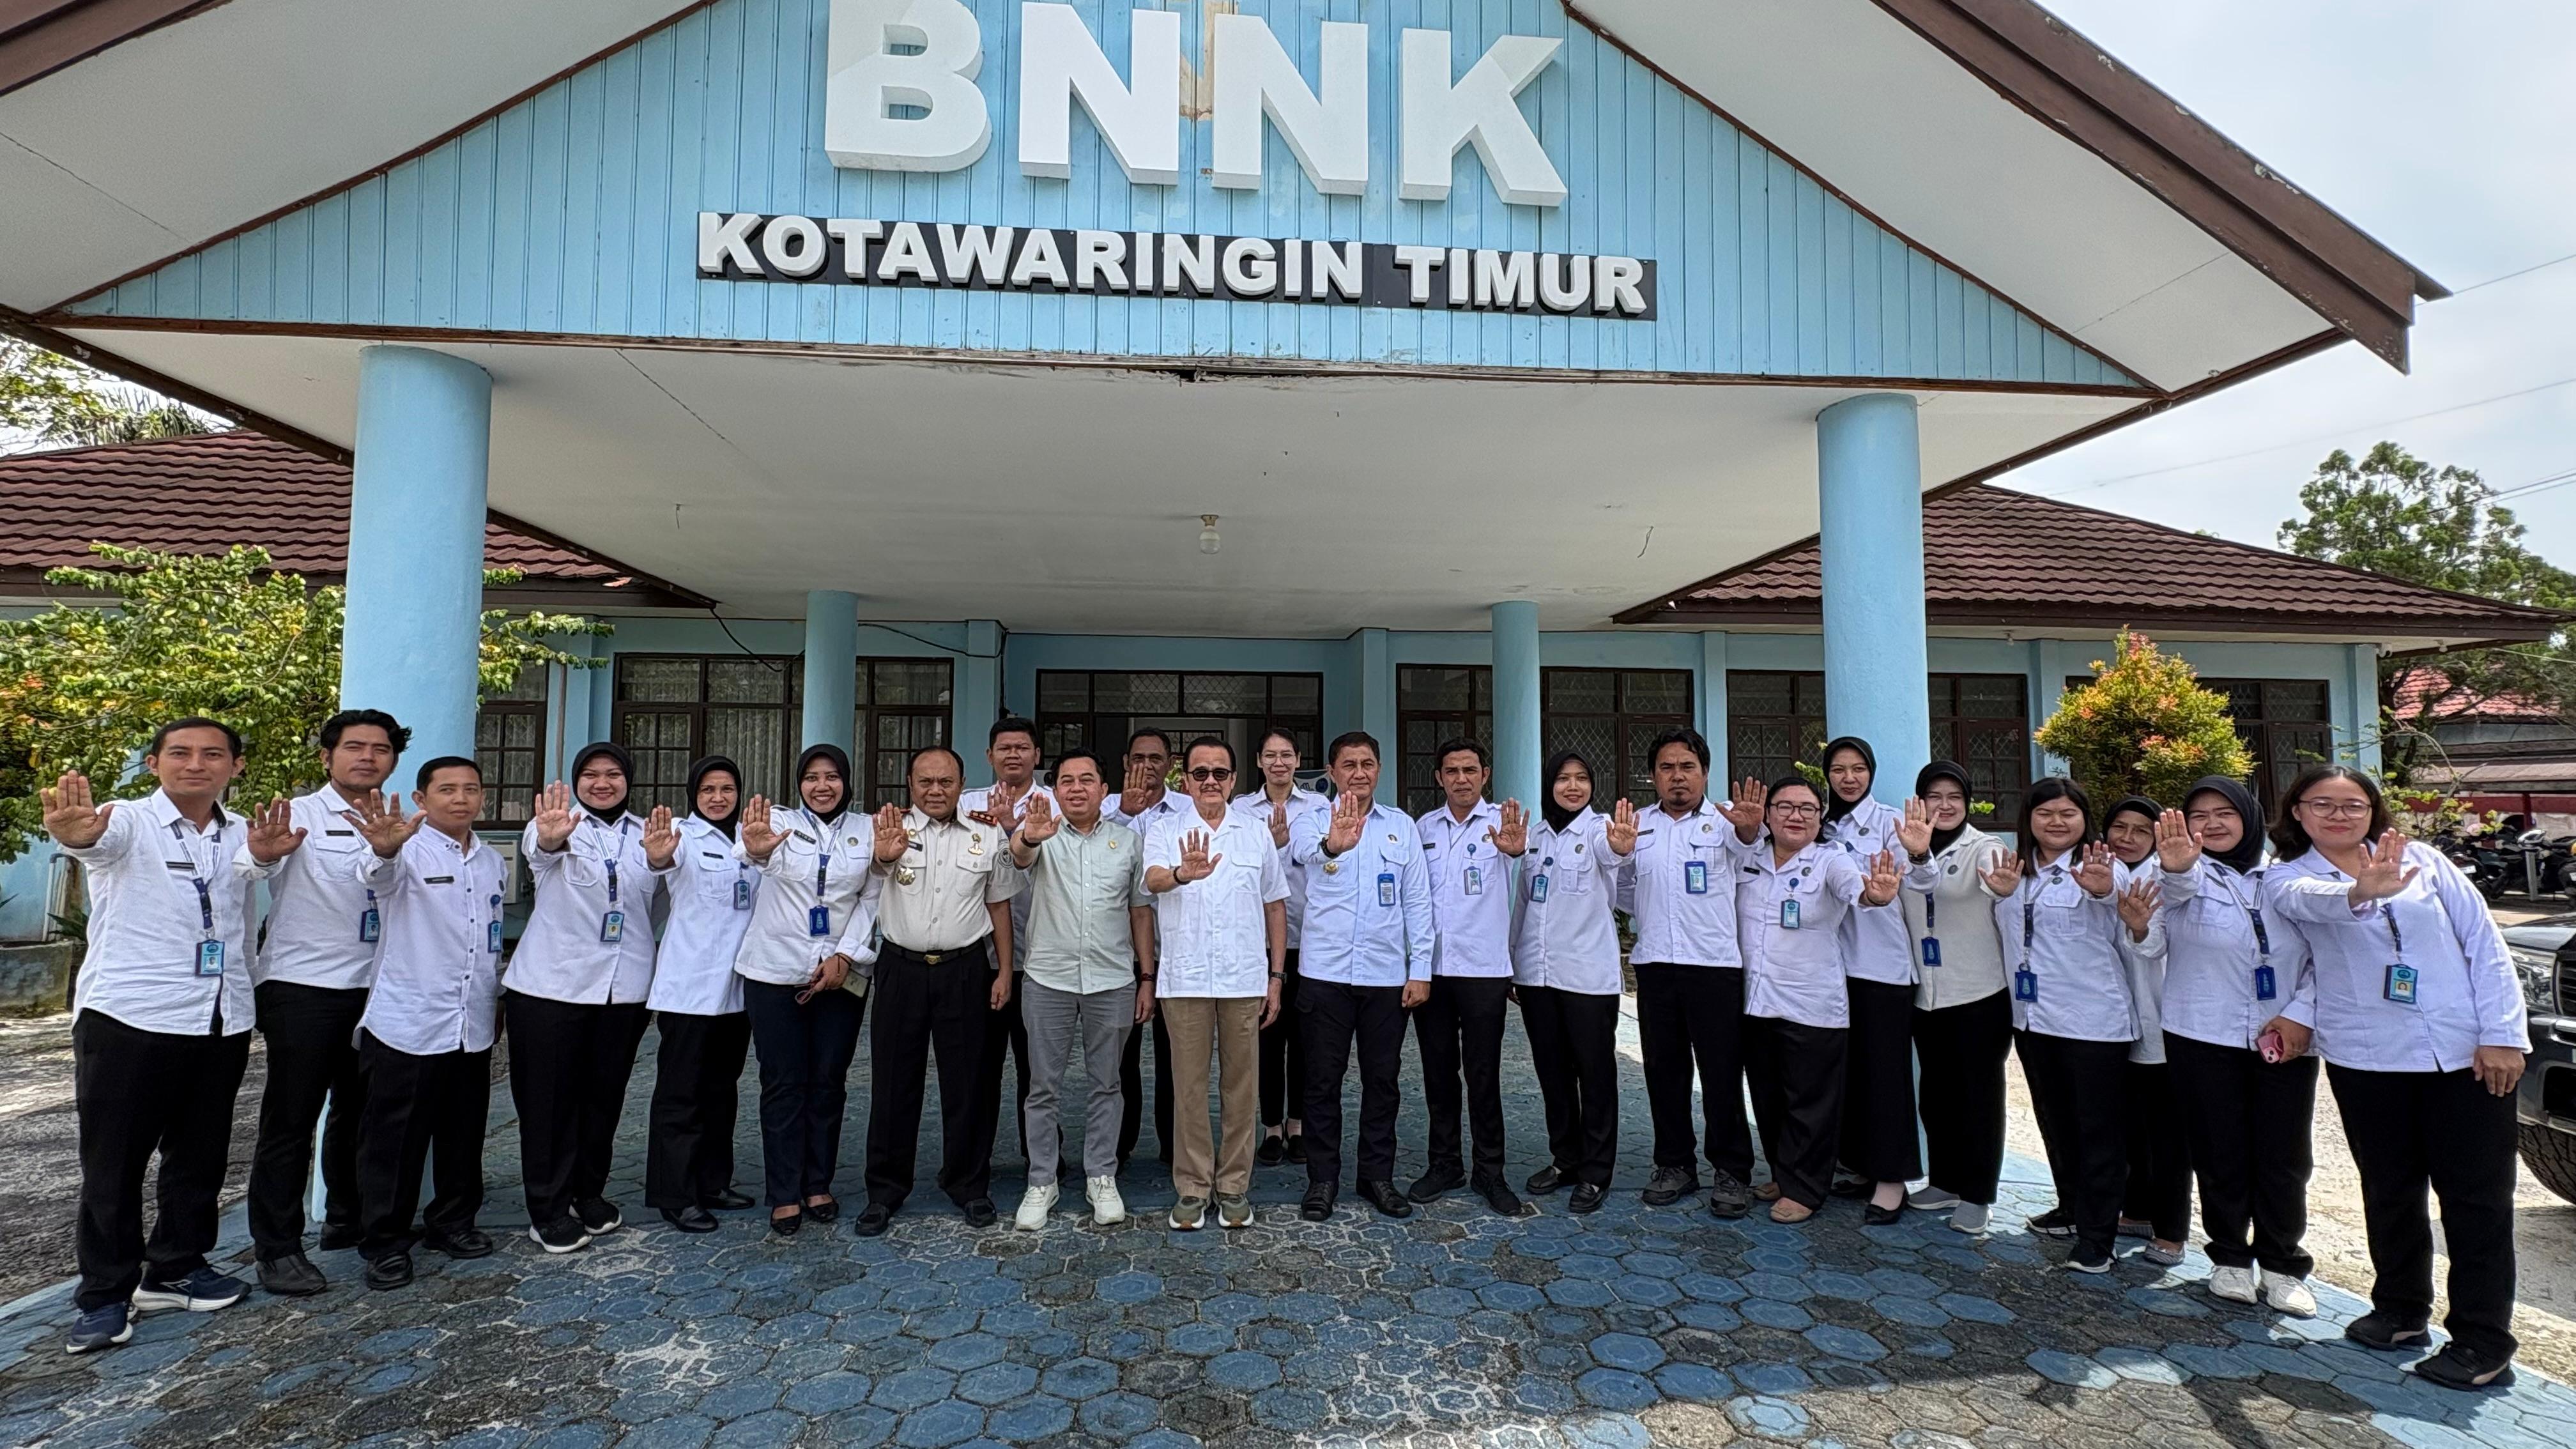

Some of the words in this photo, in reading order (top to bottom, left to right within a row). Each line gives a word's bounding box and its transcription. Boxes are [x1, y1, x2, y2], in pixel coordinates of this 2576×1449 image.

[824, 0, 1568, 206] BNNK
[698, 213, 1364, 299] KOTAWARINGIN
[1396, 245, 1647, 315] TIMUR
